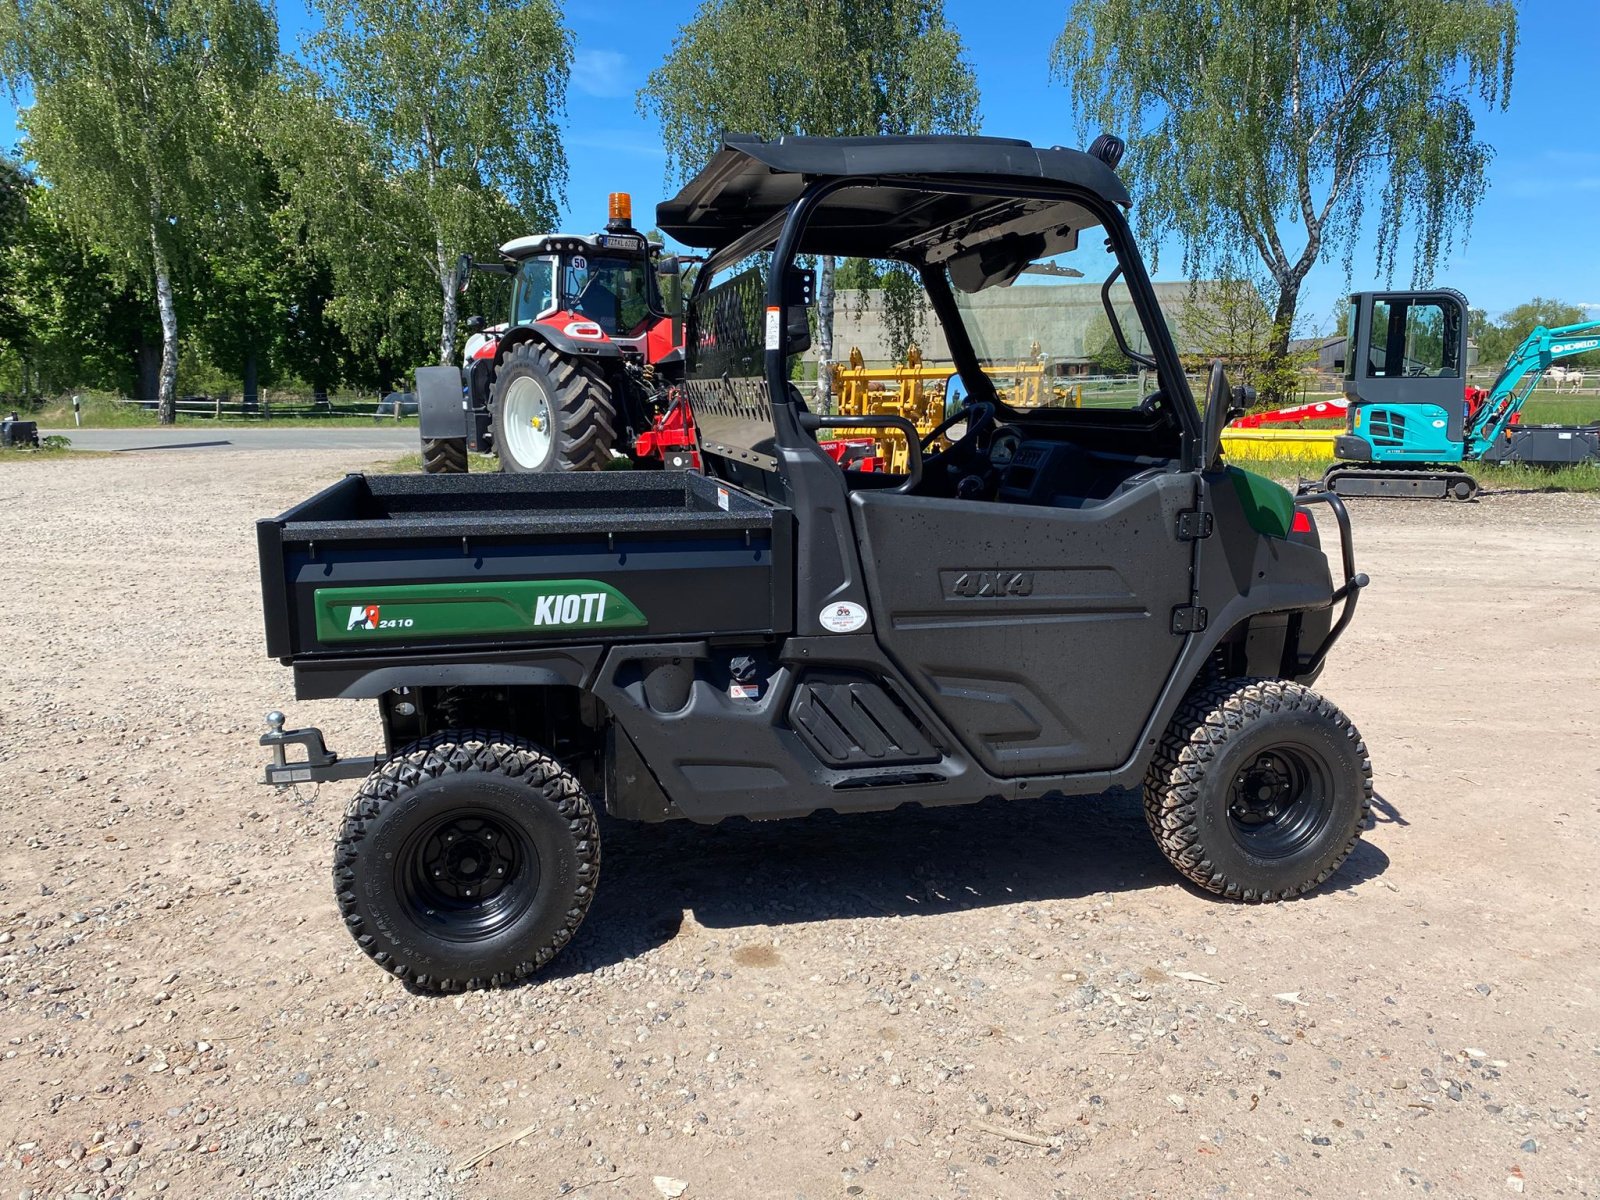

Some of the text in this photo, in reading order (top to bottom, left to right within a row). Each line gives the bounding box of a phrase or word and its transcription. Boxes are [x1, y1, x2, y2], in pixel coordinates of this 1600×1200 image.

[574, 258, 585, 268] 50
[533, 593, 607, 625] KIOTI
[379, 619, 413, 628] 2410
